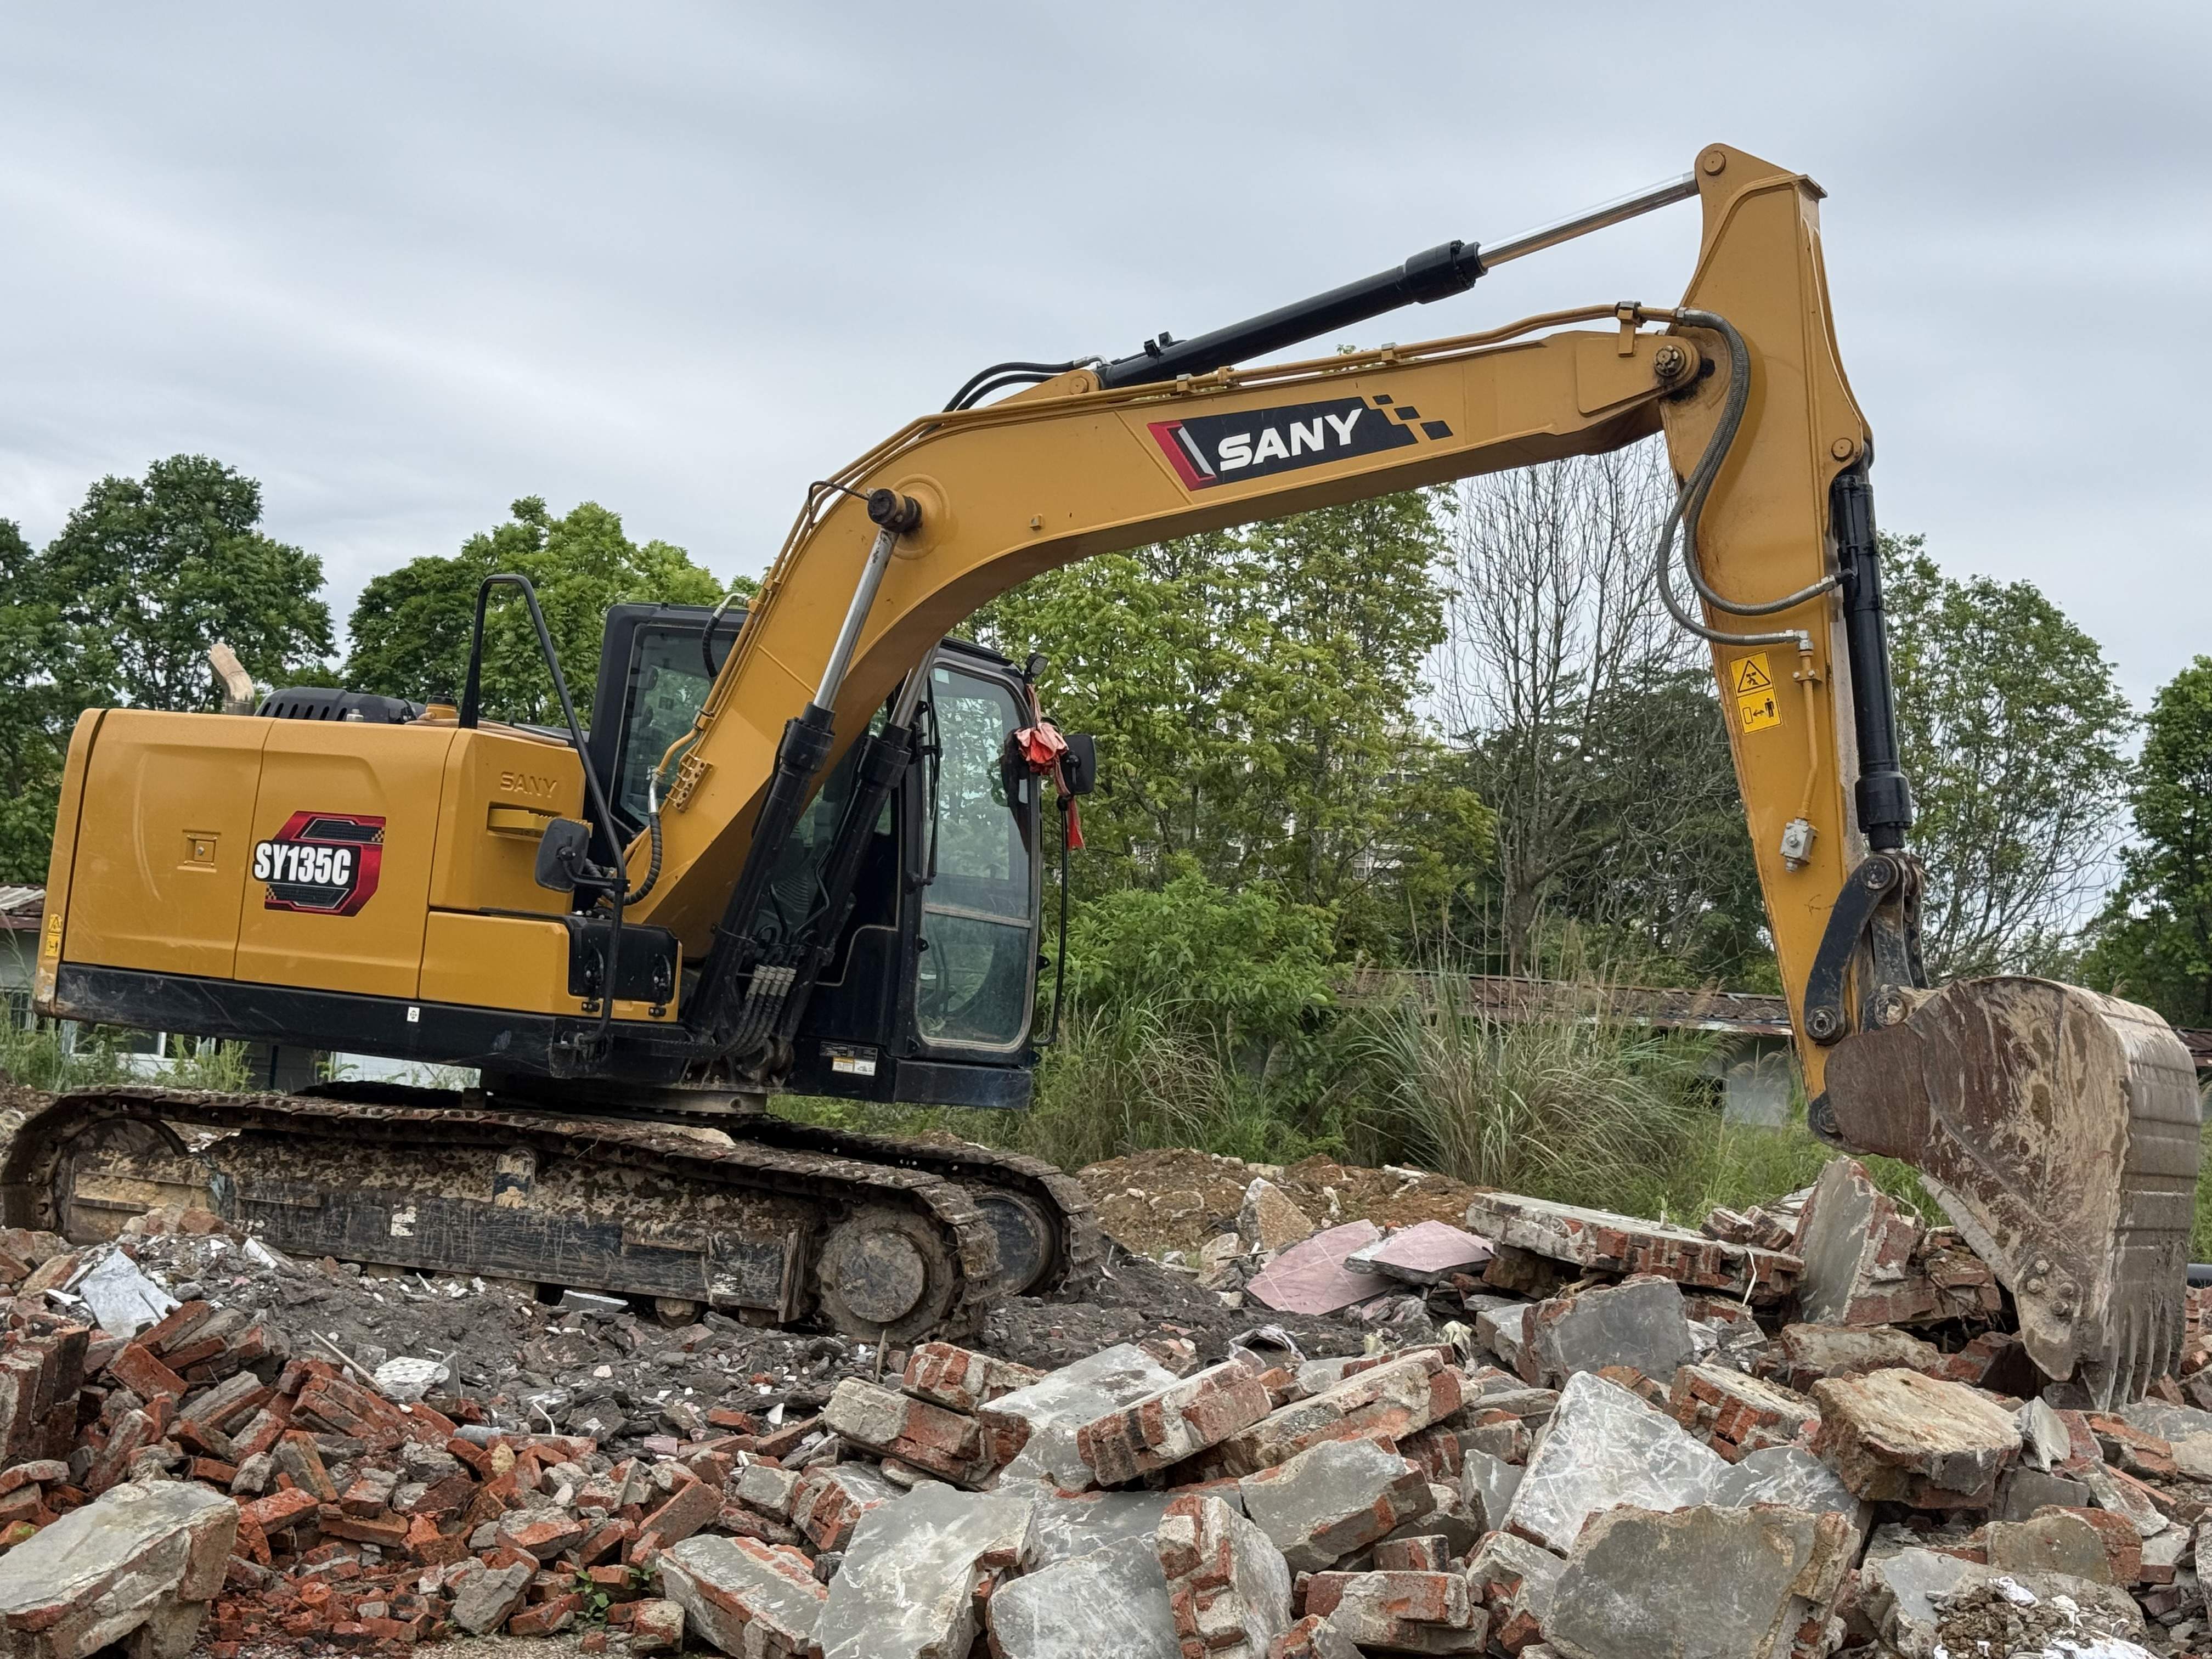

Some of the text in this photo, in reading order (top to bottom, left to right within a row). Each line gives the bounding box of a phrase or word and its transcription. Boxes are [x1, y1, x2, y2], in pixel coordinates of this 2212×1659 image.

[1218, 408, 1363, 472] SANY
[500, 771, 557, 799] SANY
[254, 842, 352, 886] SY135C
